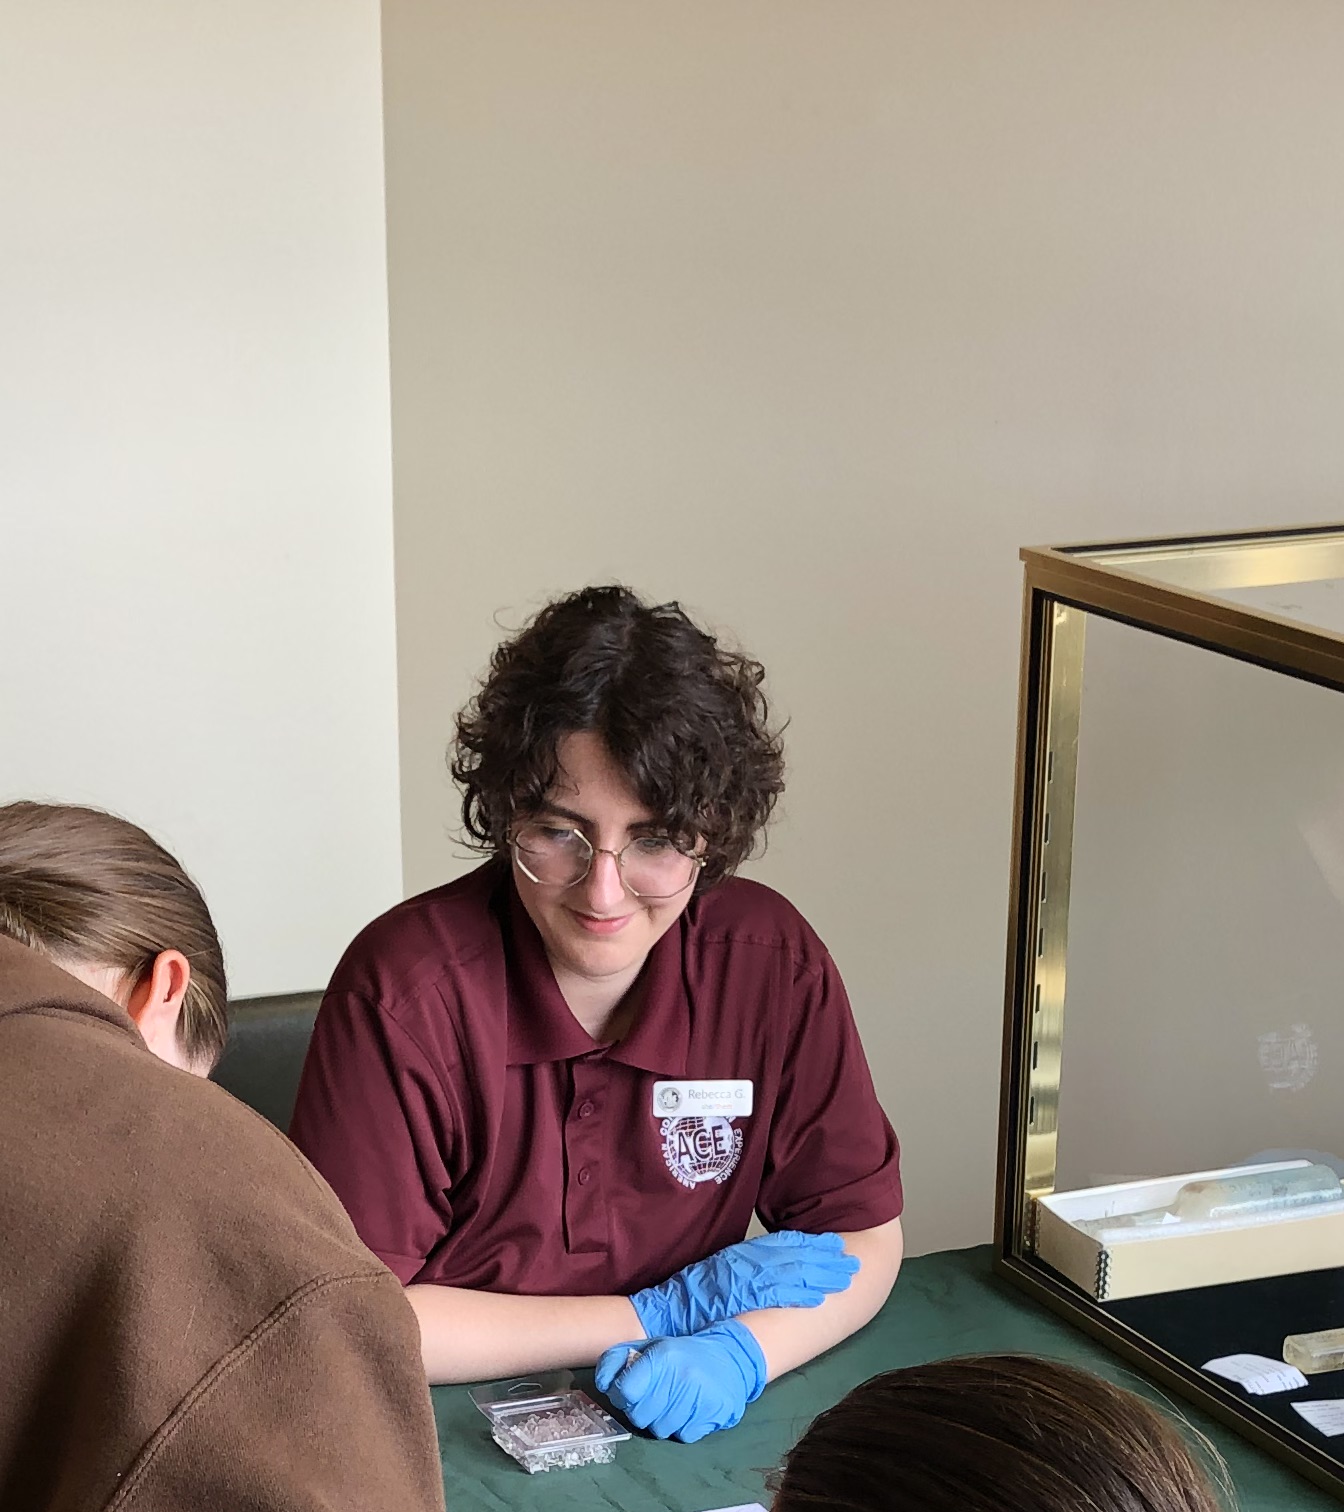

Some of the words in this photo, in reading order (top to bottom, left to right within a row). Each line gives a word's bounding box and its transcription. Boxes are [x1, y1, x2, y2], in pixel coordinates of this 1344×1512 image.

[687, 1088, 732, 1100] Rebecca
[677, 1124, 728, 1164] ACE
[714, 1127, 744, 1185] EXPERIENCE
